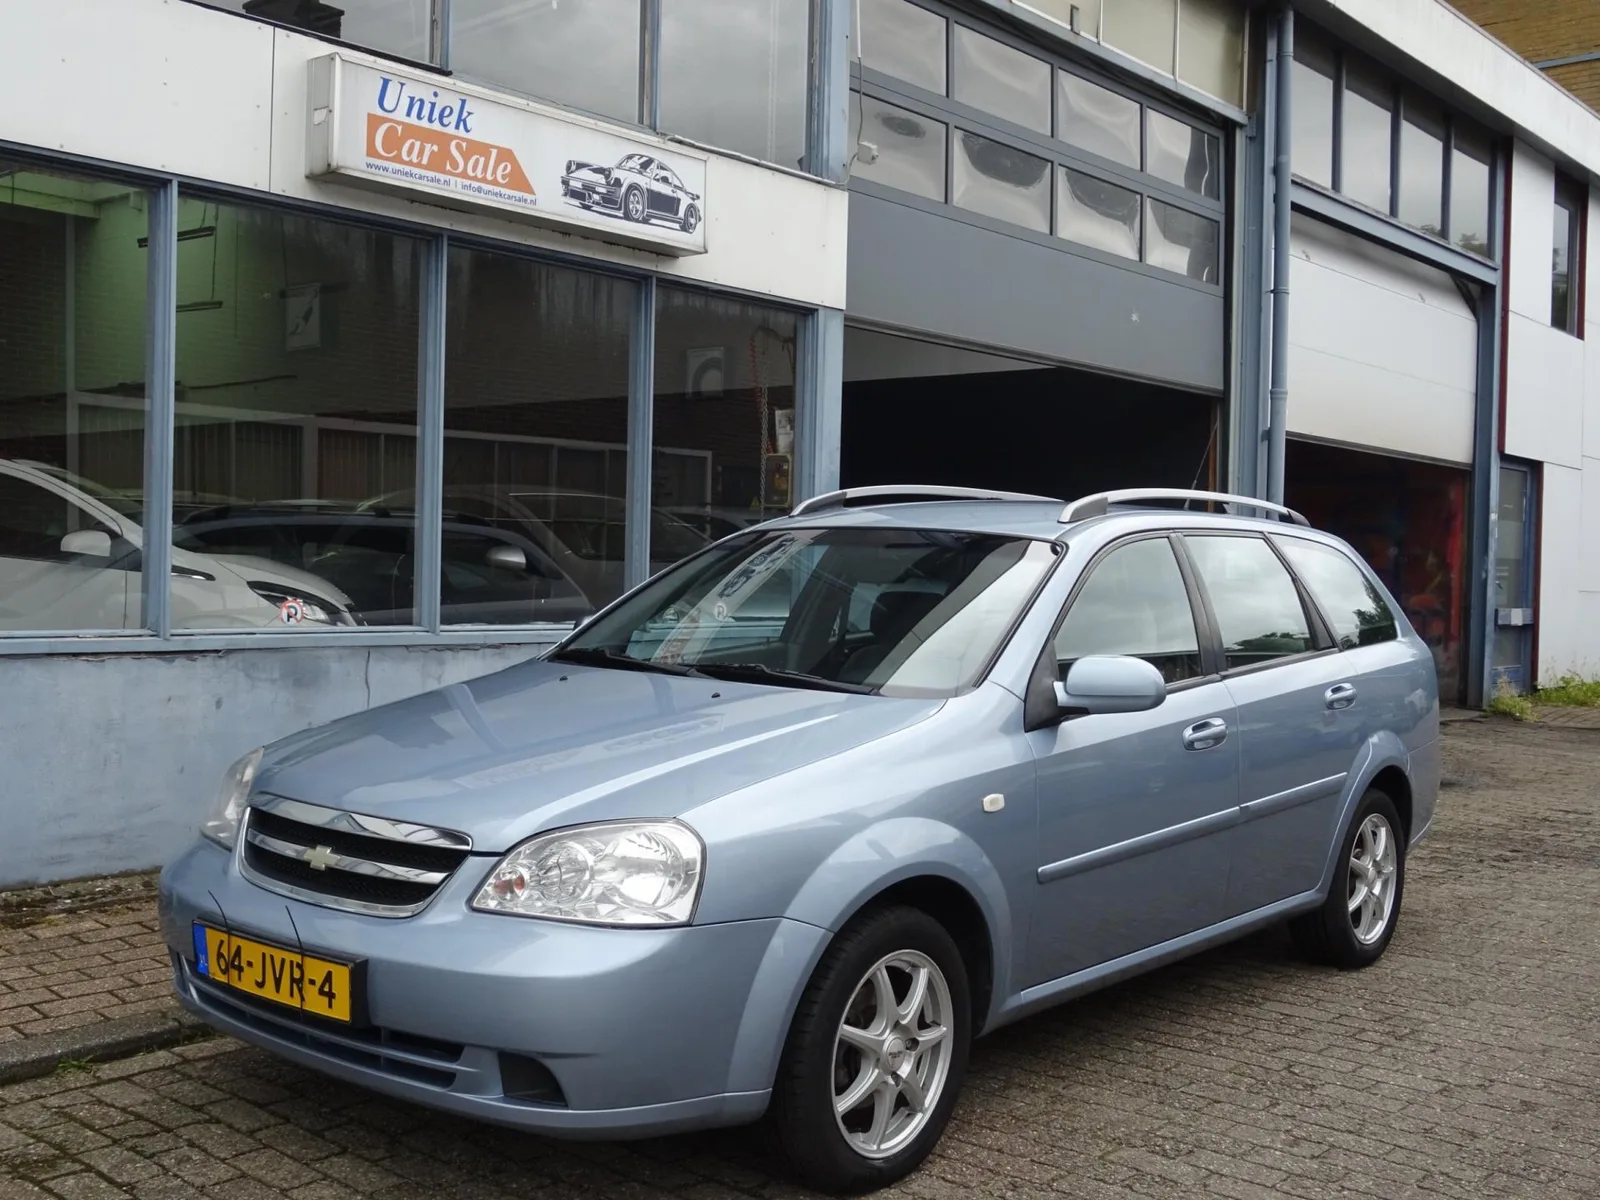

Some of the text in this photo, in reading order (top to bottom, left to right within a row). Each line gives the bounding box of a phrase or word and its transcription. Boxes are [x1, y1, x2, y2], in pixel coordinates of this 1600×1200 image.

[377, 76, 475, 134] Uniek
[374, 122, 512, 184] Car Sale
[365, 161, 537, 206] www.uniekcarsale.nl info@uniekcarsale.nl
[216, 939, 337, 1010] 64-JVR-4
